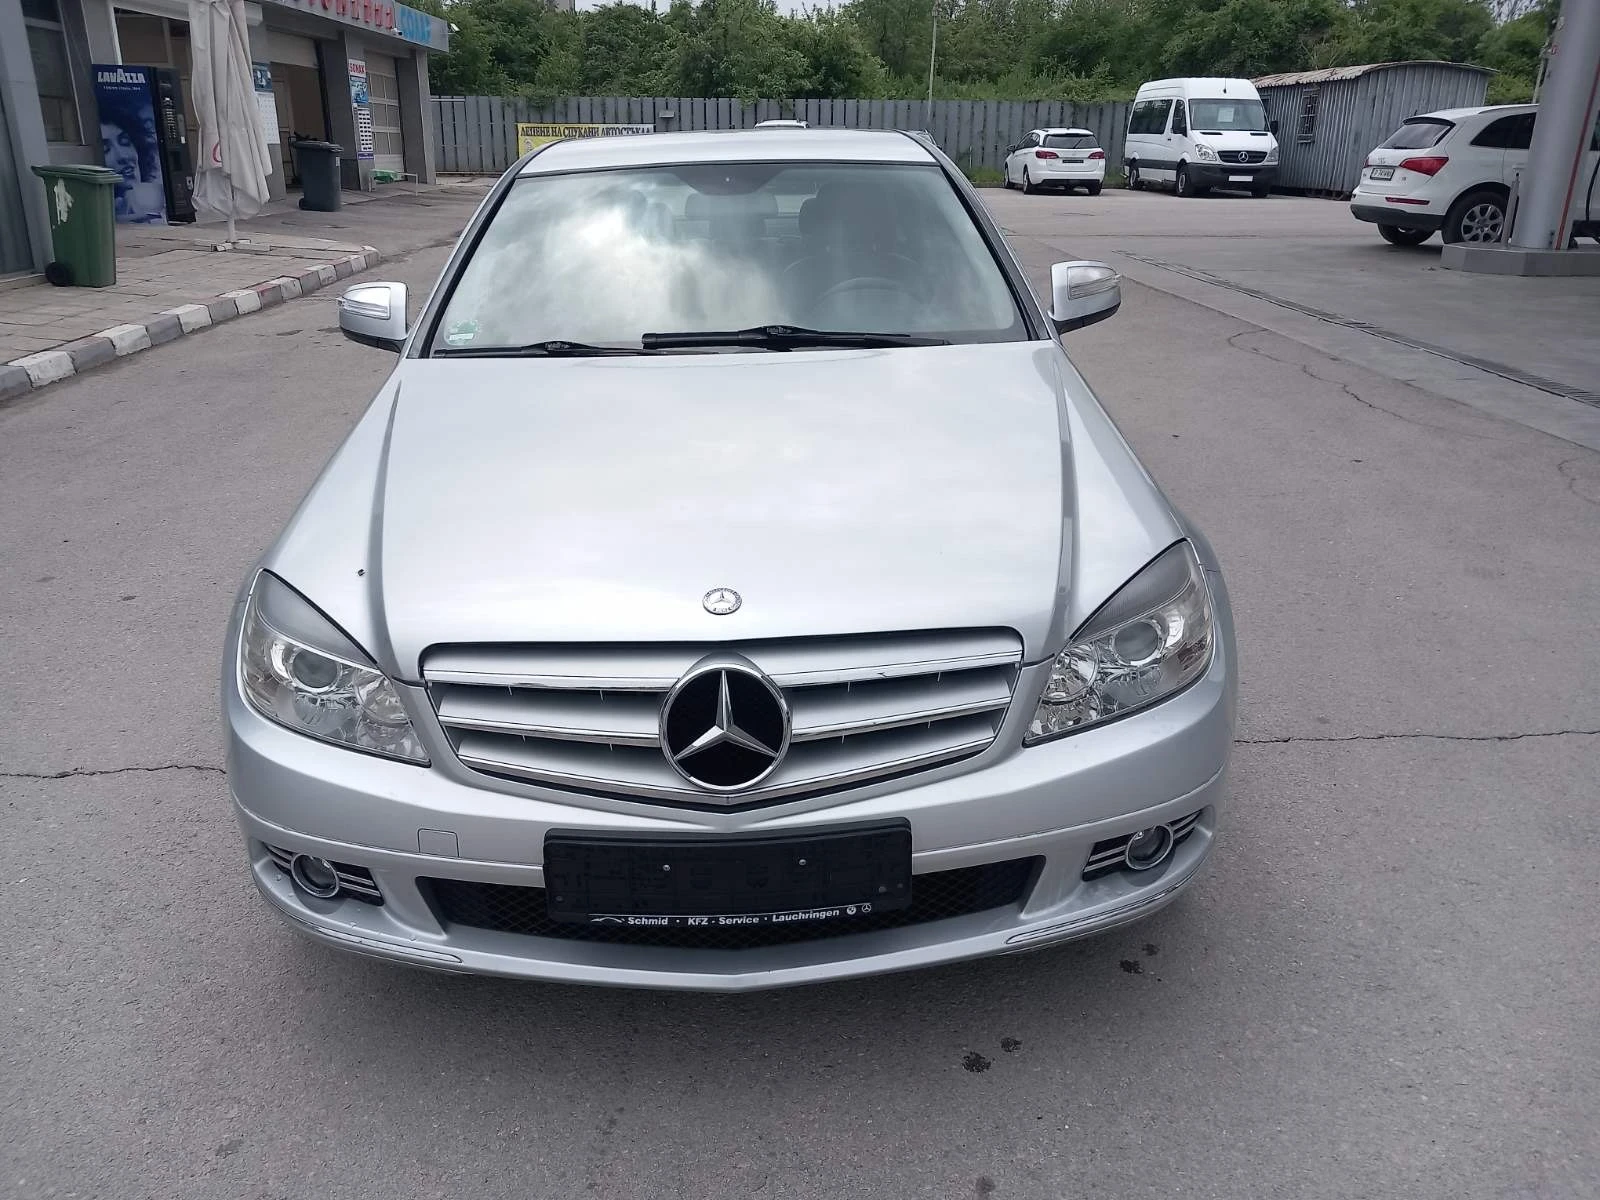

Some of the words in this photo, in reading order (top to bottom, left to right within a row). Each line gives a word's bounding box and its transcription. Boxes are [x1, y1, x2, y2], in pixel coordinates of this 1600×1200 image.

[98, 69, 146, 83] LAVAZZA
[627, 915, 668, 925] Schmid
[688, 917, 709, 926] KFZ
[720, 915, 760, 925] Service
[772, 909, 838, 923] Lauchringen
